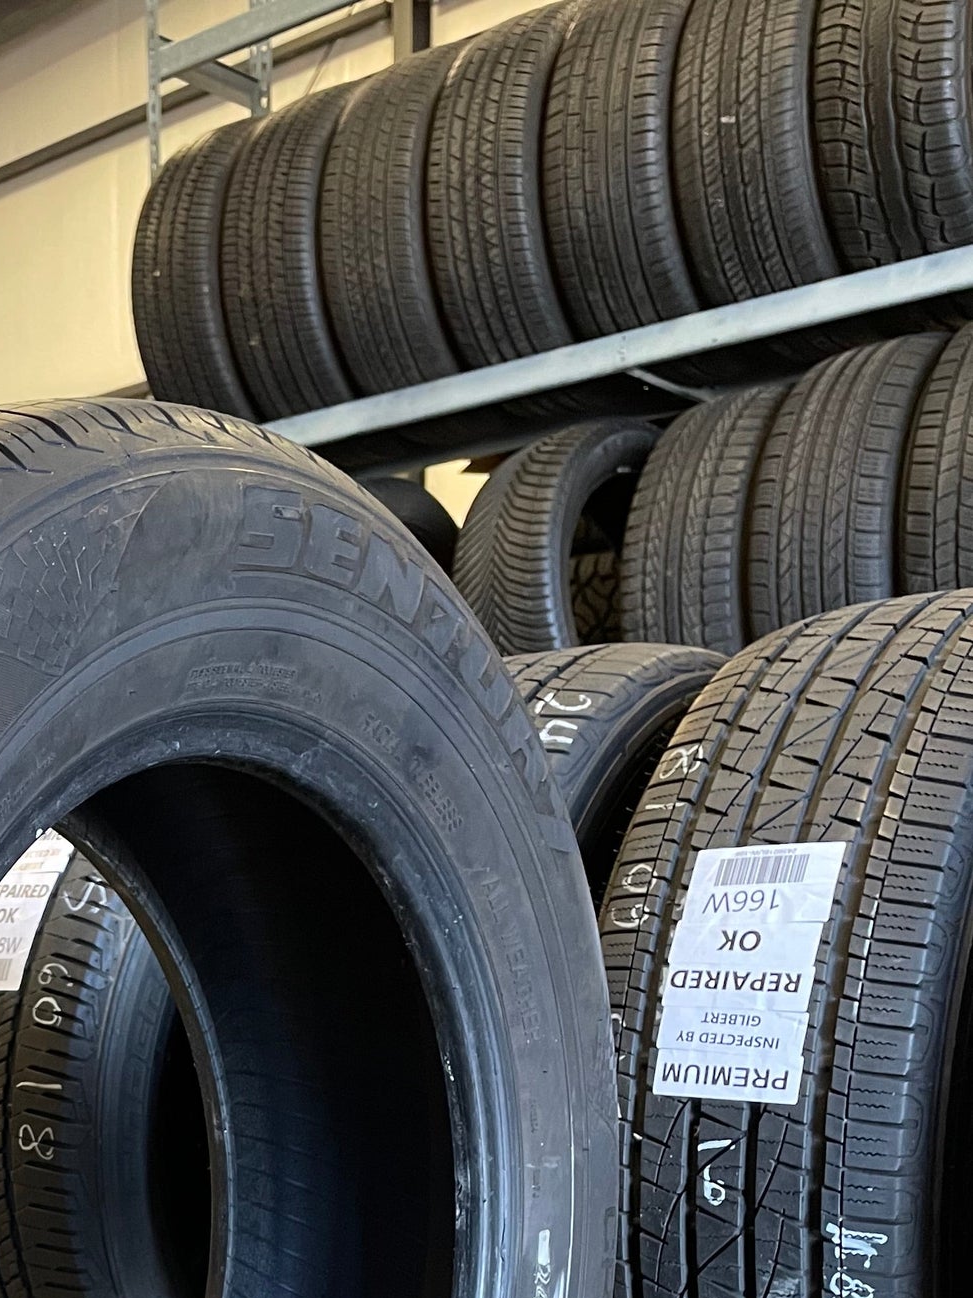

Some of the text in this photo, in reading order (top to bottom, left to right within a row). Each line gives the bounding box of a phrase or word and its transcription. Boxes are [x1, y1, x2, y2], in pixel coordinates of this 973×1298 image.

[702, 889, 780, 915] 166W
[717, 930, 762, 951] OK
[670, 969, 802, 994] REPAIRED
[701, 1011, 762, 1027] GILBERT
[675, 1030, 780, 1050] INSPECTED BY
[662, 1062, 790, 1091] PREMIUM
